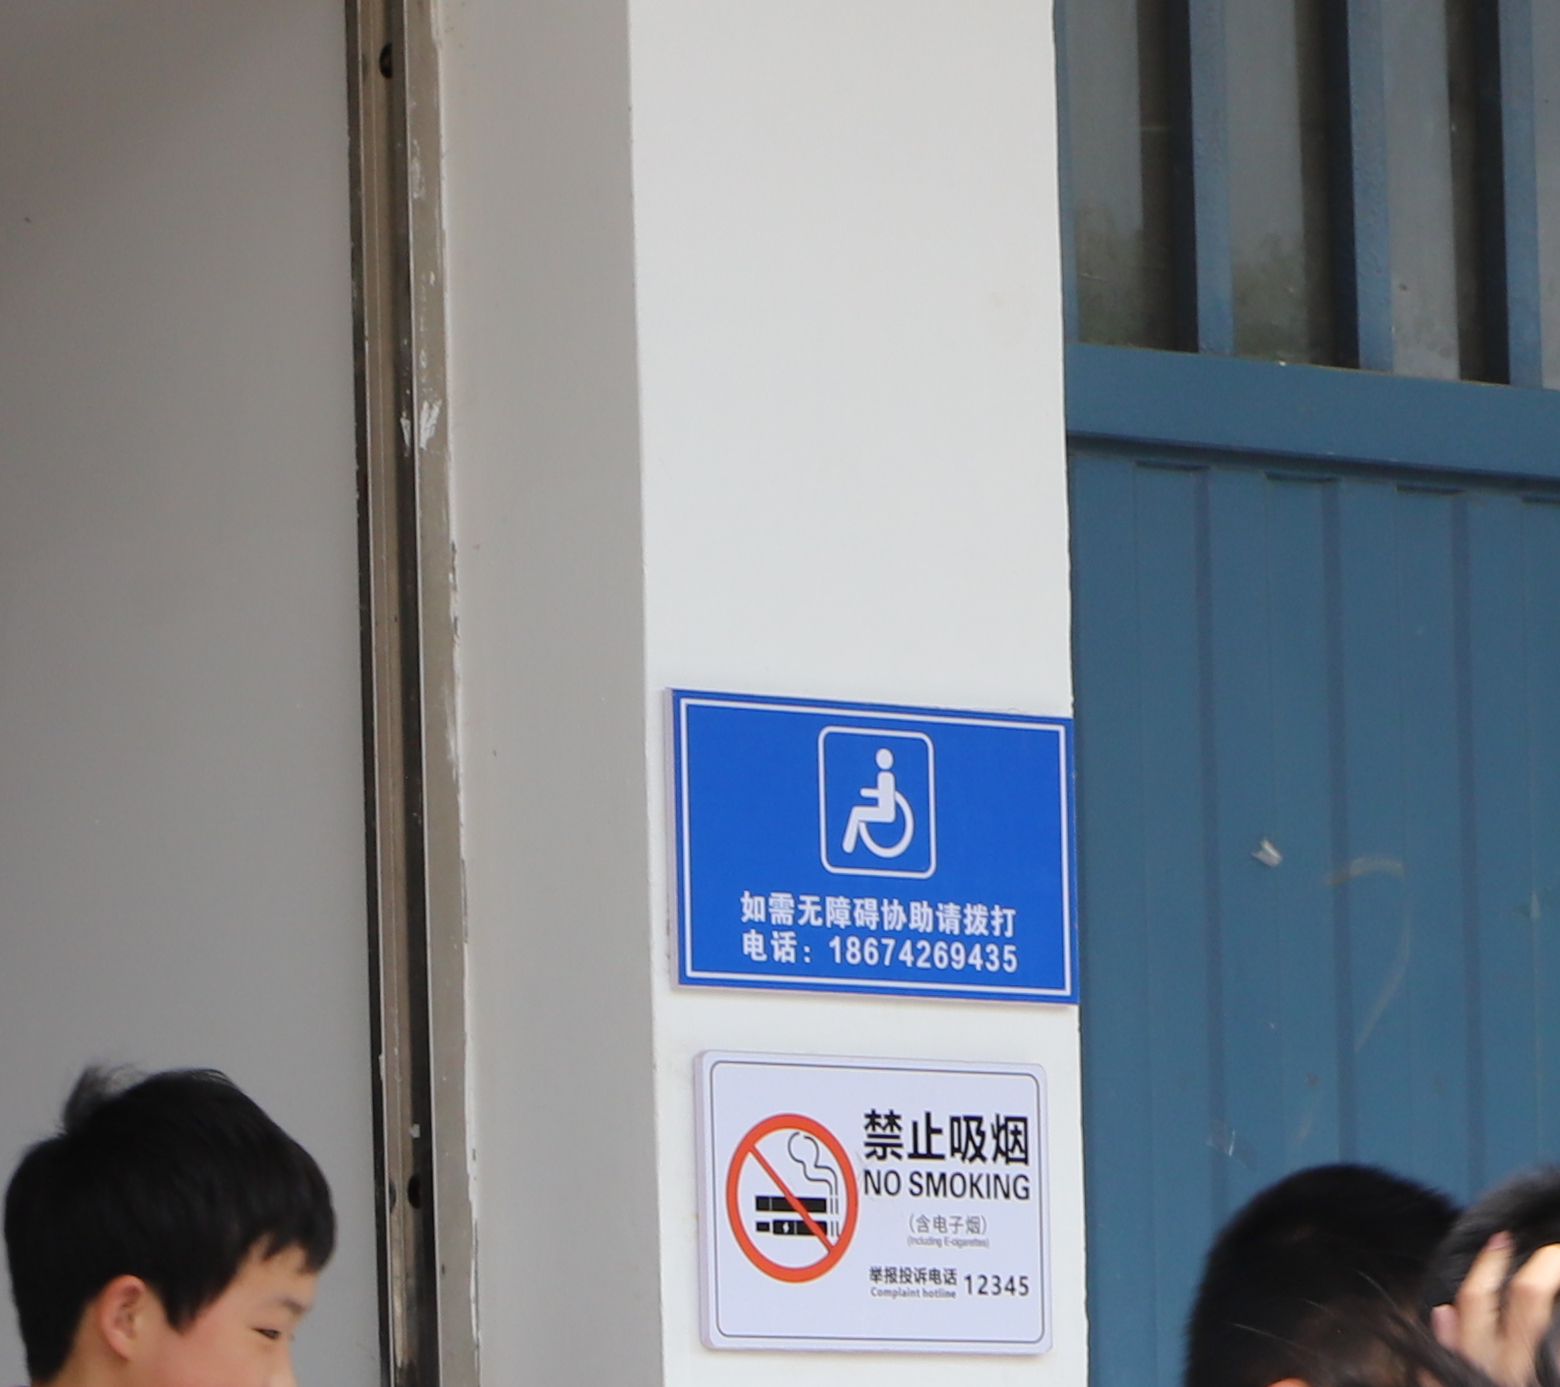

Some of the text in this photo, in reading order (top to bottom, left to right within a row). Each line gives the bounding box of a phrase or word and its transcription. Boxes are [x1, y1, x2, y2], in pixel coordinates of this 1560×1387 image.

[740, 890, 1017, 938] 如需无障碍协助请拨打
[863, 1108, 1029, 1165] 禁止吸烟
[863, 1169, 1030, 1201] NO SMOKING
[868, 1265, 1030, 1297] 举报投诉电话 12345
[870, 1286, 957, 1301] Complaint hotline
